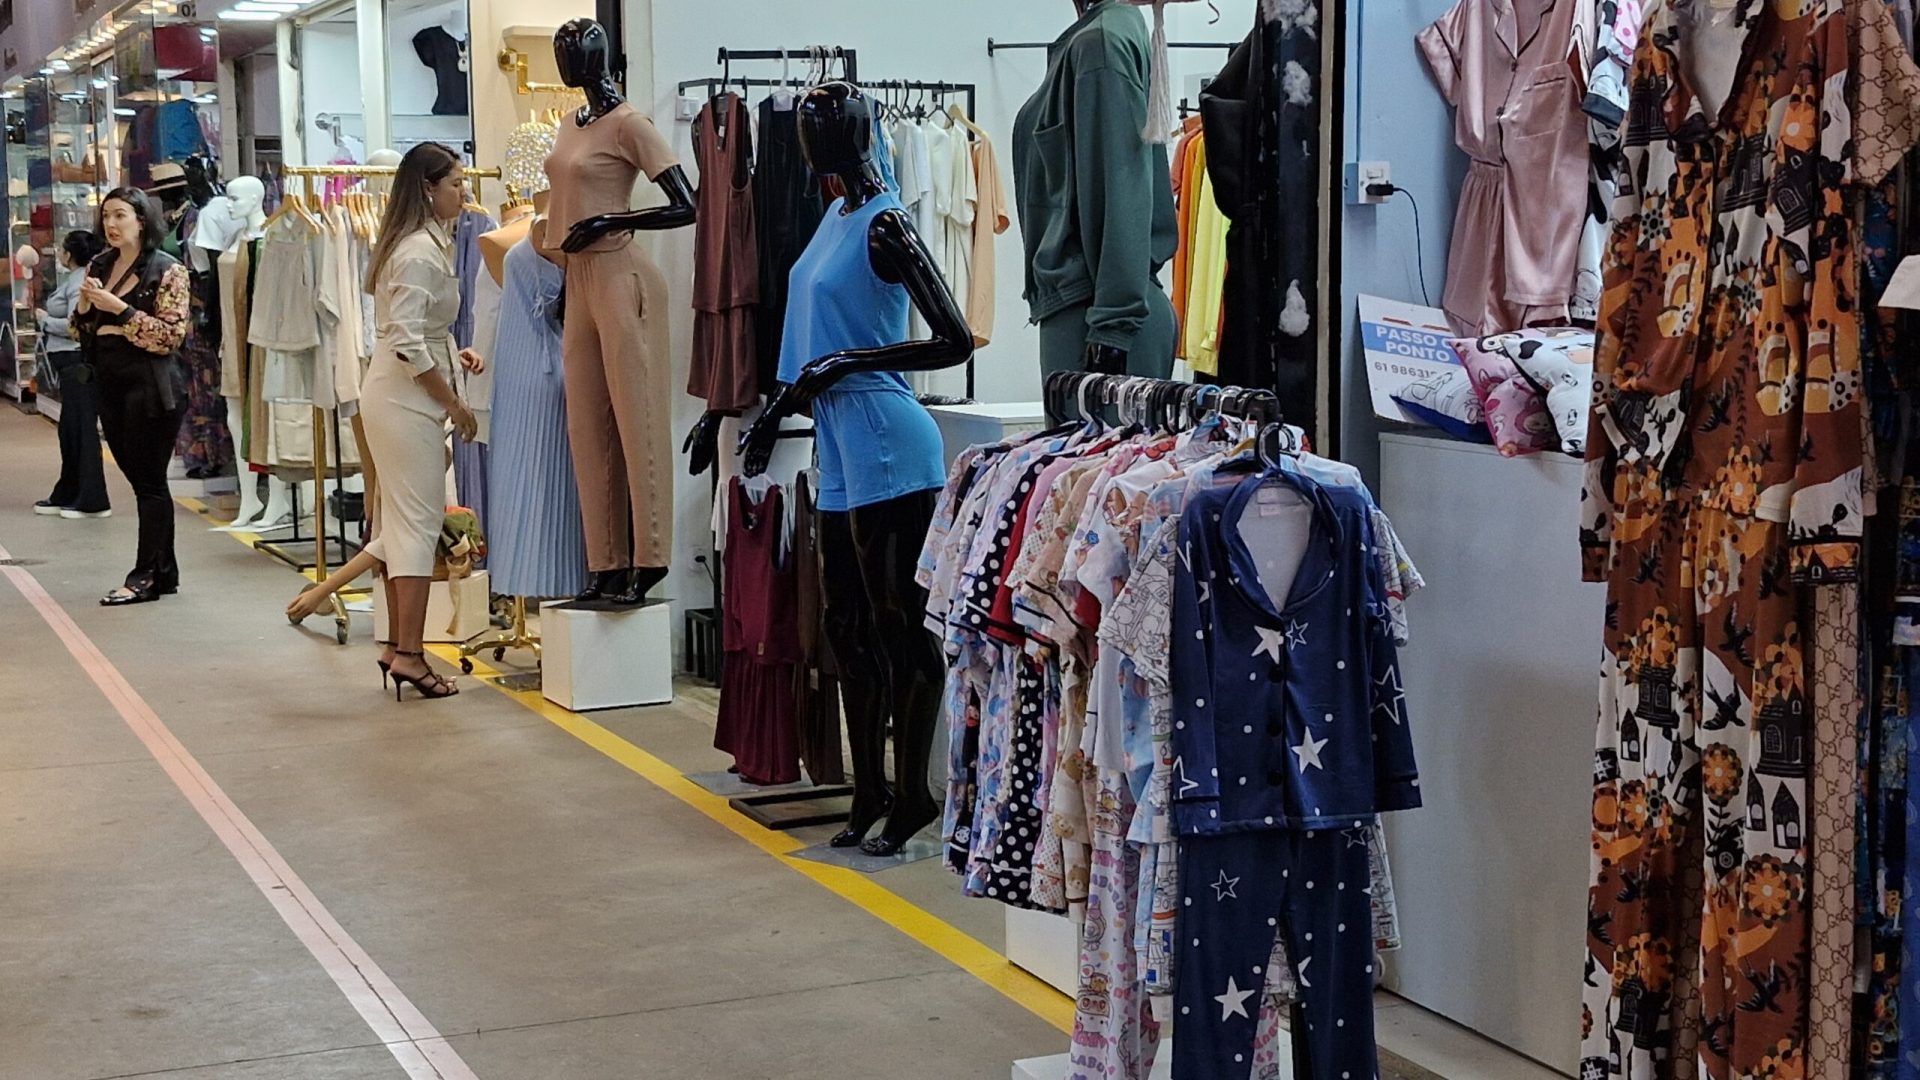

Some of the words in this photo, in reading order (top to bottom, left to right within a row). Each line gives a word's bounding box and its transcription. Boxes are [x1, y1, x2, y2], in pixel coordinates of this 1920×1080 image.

[1376, 325, 1438, 347] PASSO
[1385, 341, 1450, 362] PONTO
[1374, 361, 1388, 372] 61
